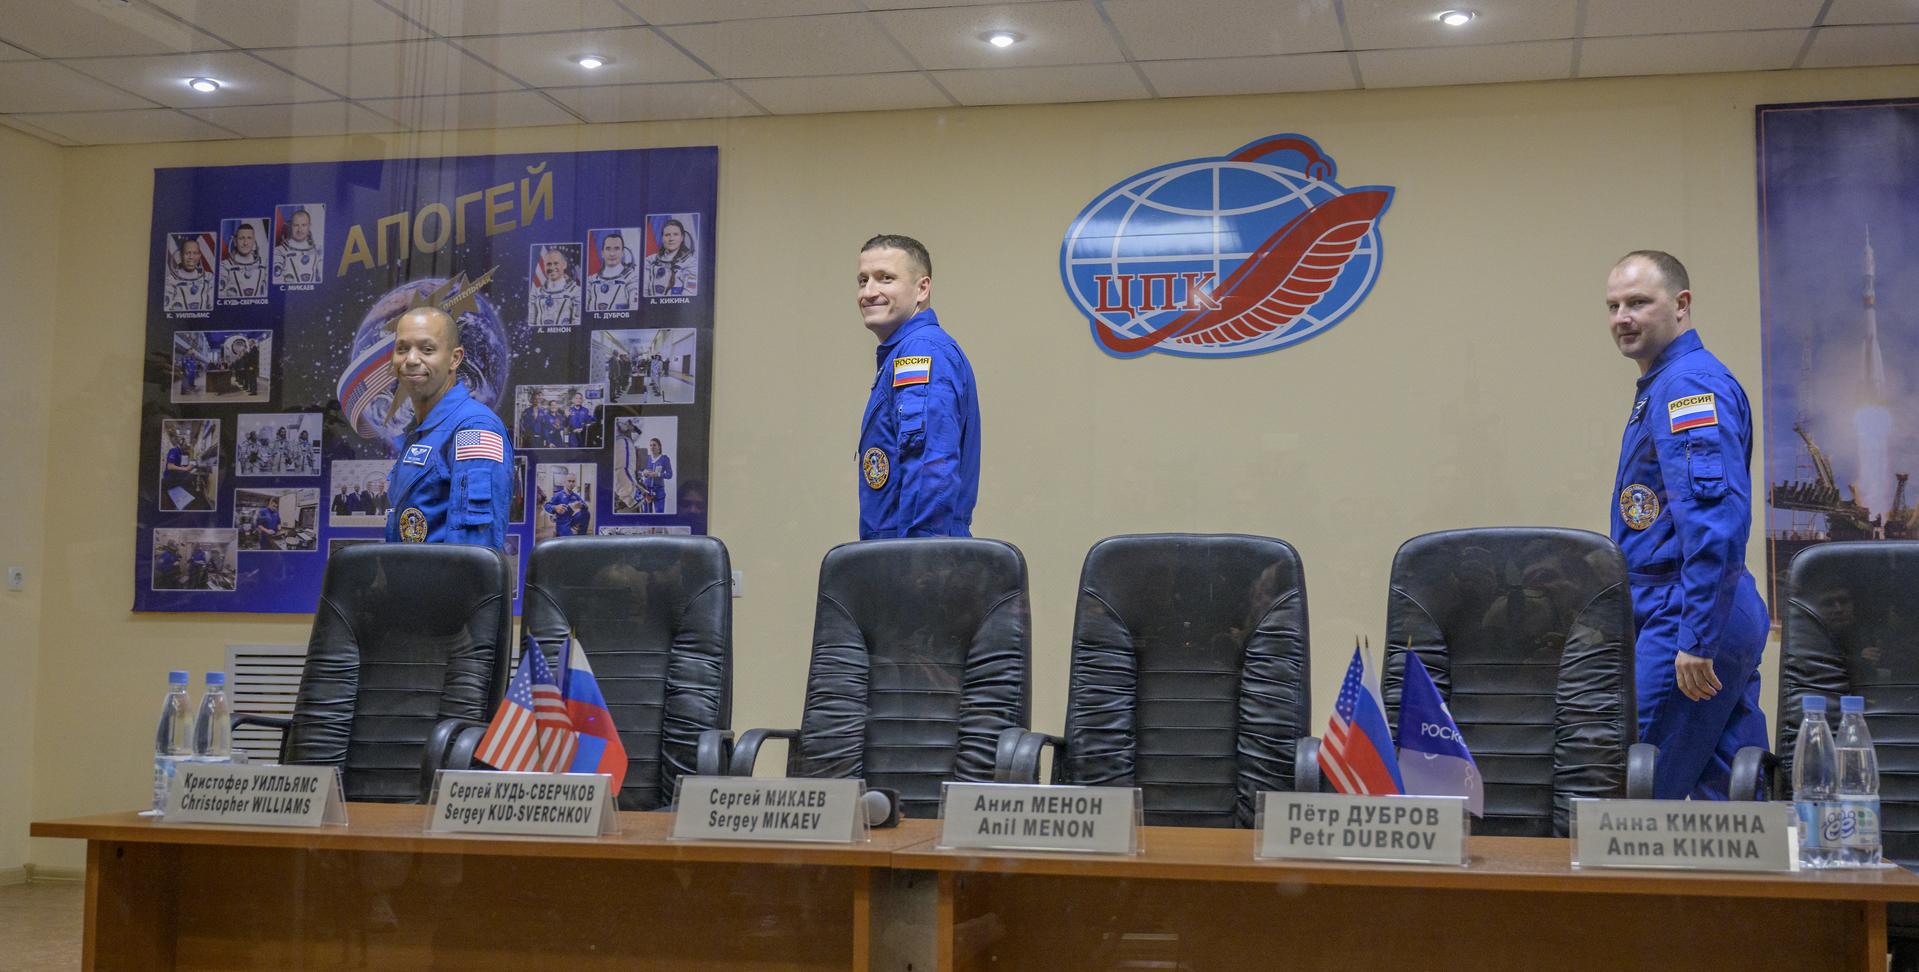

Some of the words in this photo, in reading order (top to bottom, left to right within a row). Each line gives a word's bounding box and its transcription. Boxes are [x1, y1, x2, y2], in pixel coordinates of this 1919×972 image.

[336, 161, 554, 278] АПОГЕЙ
[659, 297, 690, 305] КИКИНА
[1094, 272, 1222, 319] ЦПК
[603, 312, 630, 320] ДУБРОВ
[895, 357, 930, 367] РОССИЯ
[1670, 394, 1713, 411] РОССИЯ
[184, 772, 249, 795] Кристофер
[251, 775, 319, 793] УИЛЛЬЯМС
[450, 781, 492, 802] Сергей
[494, 782, 595, 802] КУДЬ-СВЕРЧКОВ
[181, 794, 250, 815] Christopher
[251, 796, 311, 815] WILLIAMS
[710, 788, 761, 809] Сергей
[765, 789, 826, 808] МИКАЕВ
[974, 794, 1024, 813] Анил
[1031, 796, 1103, 815] МЕНОН
[444, 803, 486, 825] Sergey
[487, 804, 593, 824] KUD-SVERCHKOV
[708, 810, 759, 833] Sergey
[762, 811, 822, 830] MIKAEV
[1288, 803, 1340, 827] Пётр
[1347, 805, 1440, 827] ДУБРОВ
[1599, 812, 1658, 832] Анна
[1666, 813, 1766, 834] КИКИНА
[977, 817, 1017, 836] Anil
[1022, 818, 1095, 838] MENON
[1289, 827, 1336, 846] Petr
[1342, 828, 1437, 850] DUBROV
[1606, 837, 1665, 857] Anna
[1672, 838, 1760, 859] KIKINA
